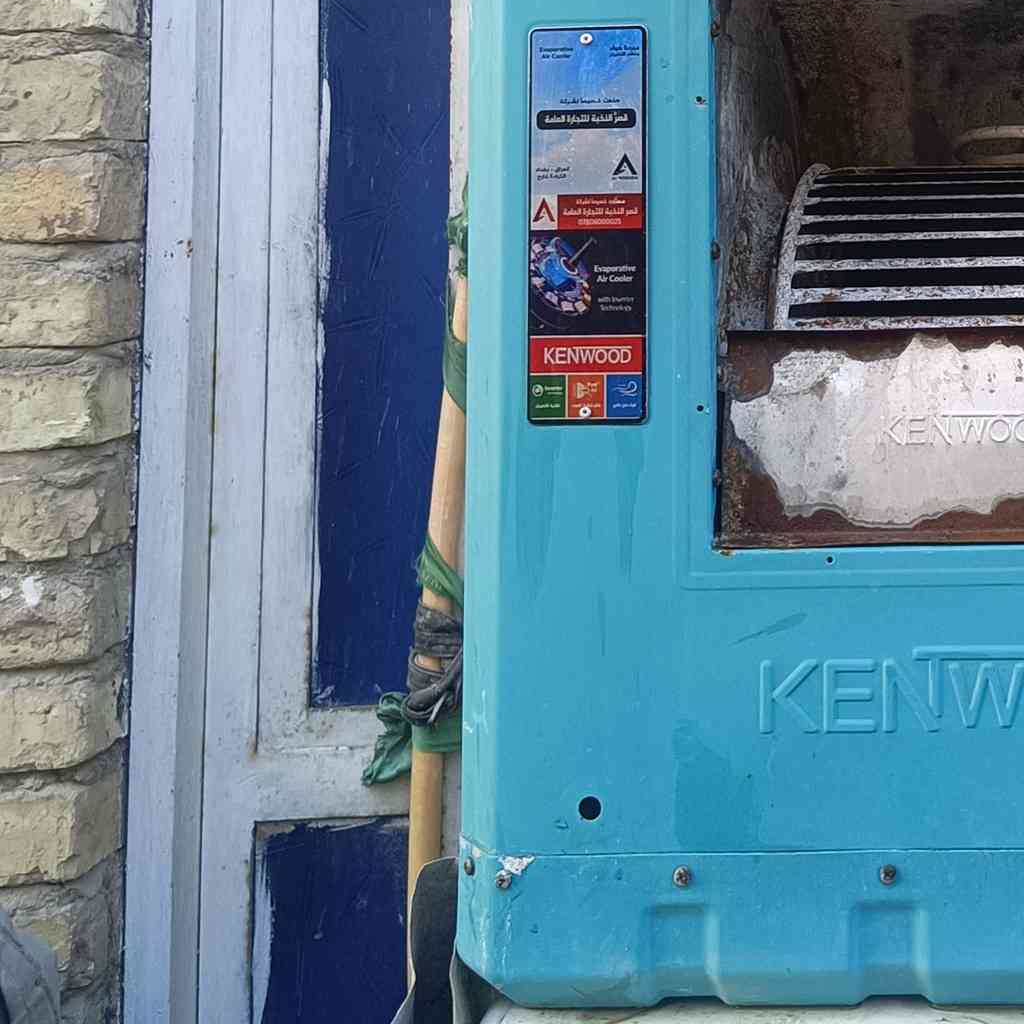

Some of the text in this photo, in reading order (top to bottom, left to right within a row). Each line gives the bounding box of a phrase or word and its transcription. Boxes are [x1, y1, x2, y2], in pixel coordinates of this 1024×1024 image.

[593, 265, 637, 275] Evaporative
[609, 275, 633, 283] Cooler
[543, 345, 633, 365] KENWOOD
